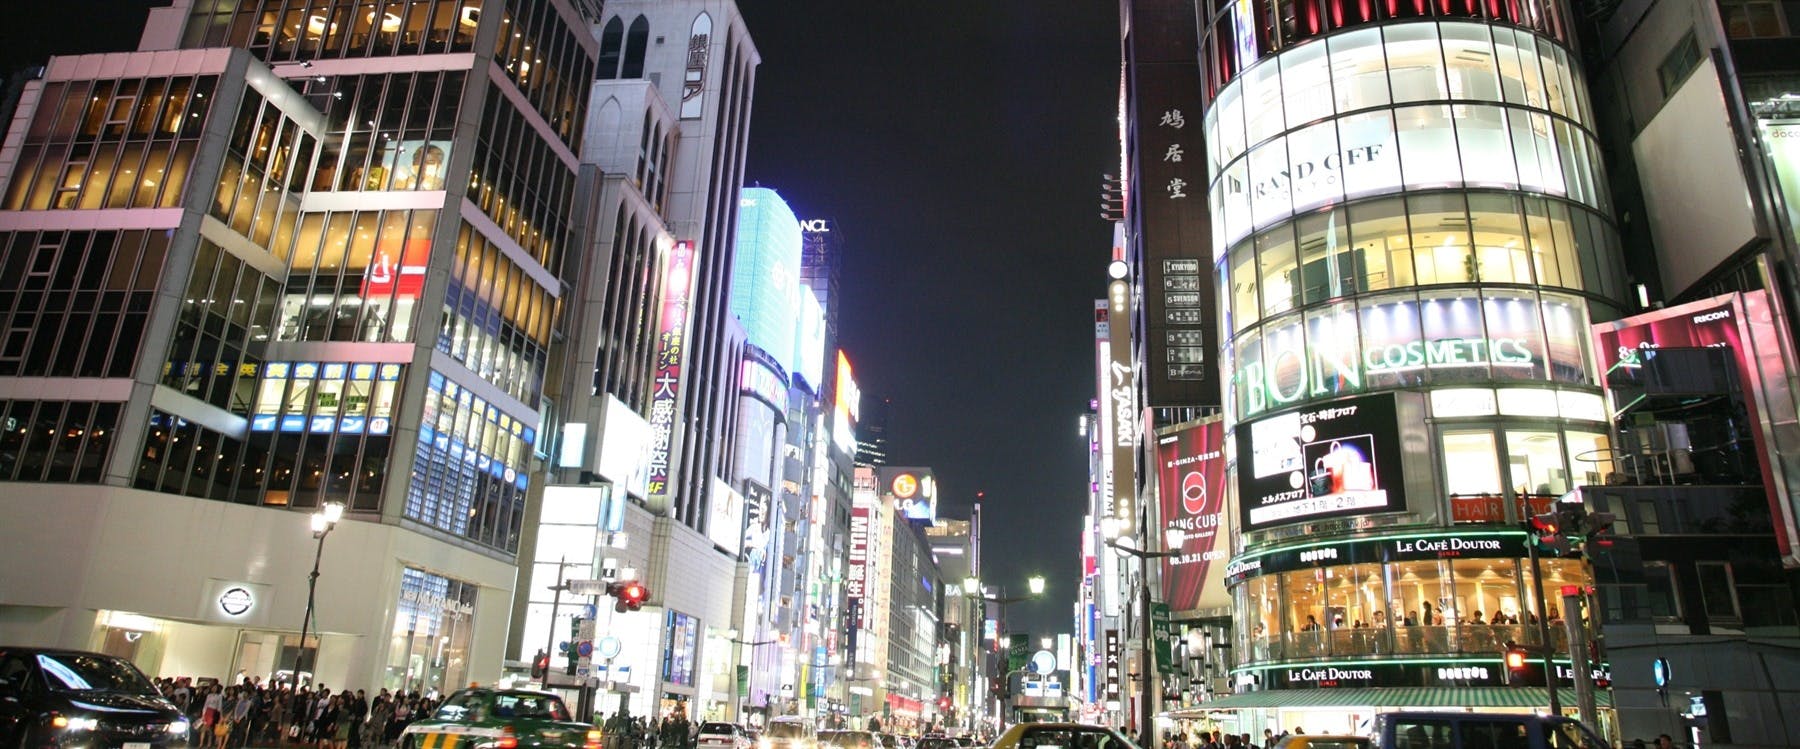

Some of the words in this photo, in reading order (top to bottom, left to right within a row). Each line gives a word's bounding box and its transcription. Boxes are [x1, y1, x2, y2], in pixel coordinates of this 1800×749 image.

[682, 33, 709, 103] 銀座コア
[1159, 109, 1187, 199] 鳩居堂
[800, 219, 829, 232] NCL
[1693, 310, 1730, 324] RICOH
[1366, 337, 1532, 370] COSMETICS
[252, 415, 364, 433] イーオン
[649, 372, 677, 476] 大感謝祭
[1112, 386, 1133, 447] TASAKI
[1261, 489, 1305, 505] エルメスフロア
[1456, 504, 1499, 518] HAIR
[1195, 512, 1223, 529] CUBE
[850, 516, 868, 560] MUJI
[1415, 539, 1449, 552] CAFÉ
[1450, 537, 1501, 551] DOUTOR
[1301, 669, 1328, 681] CAFÉ
[1328, 667, 1373, 680] DOUTOR
